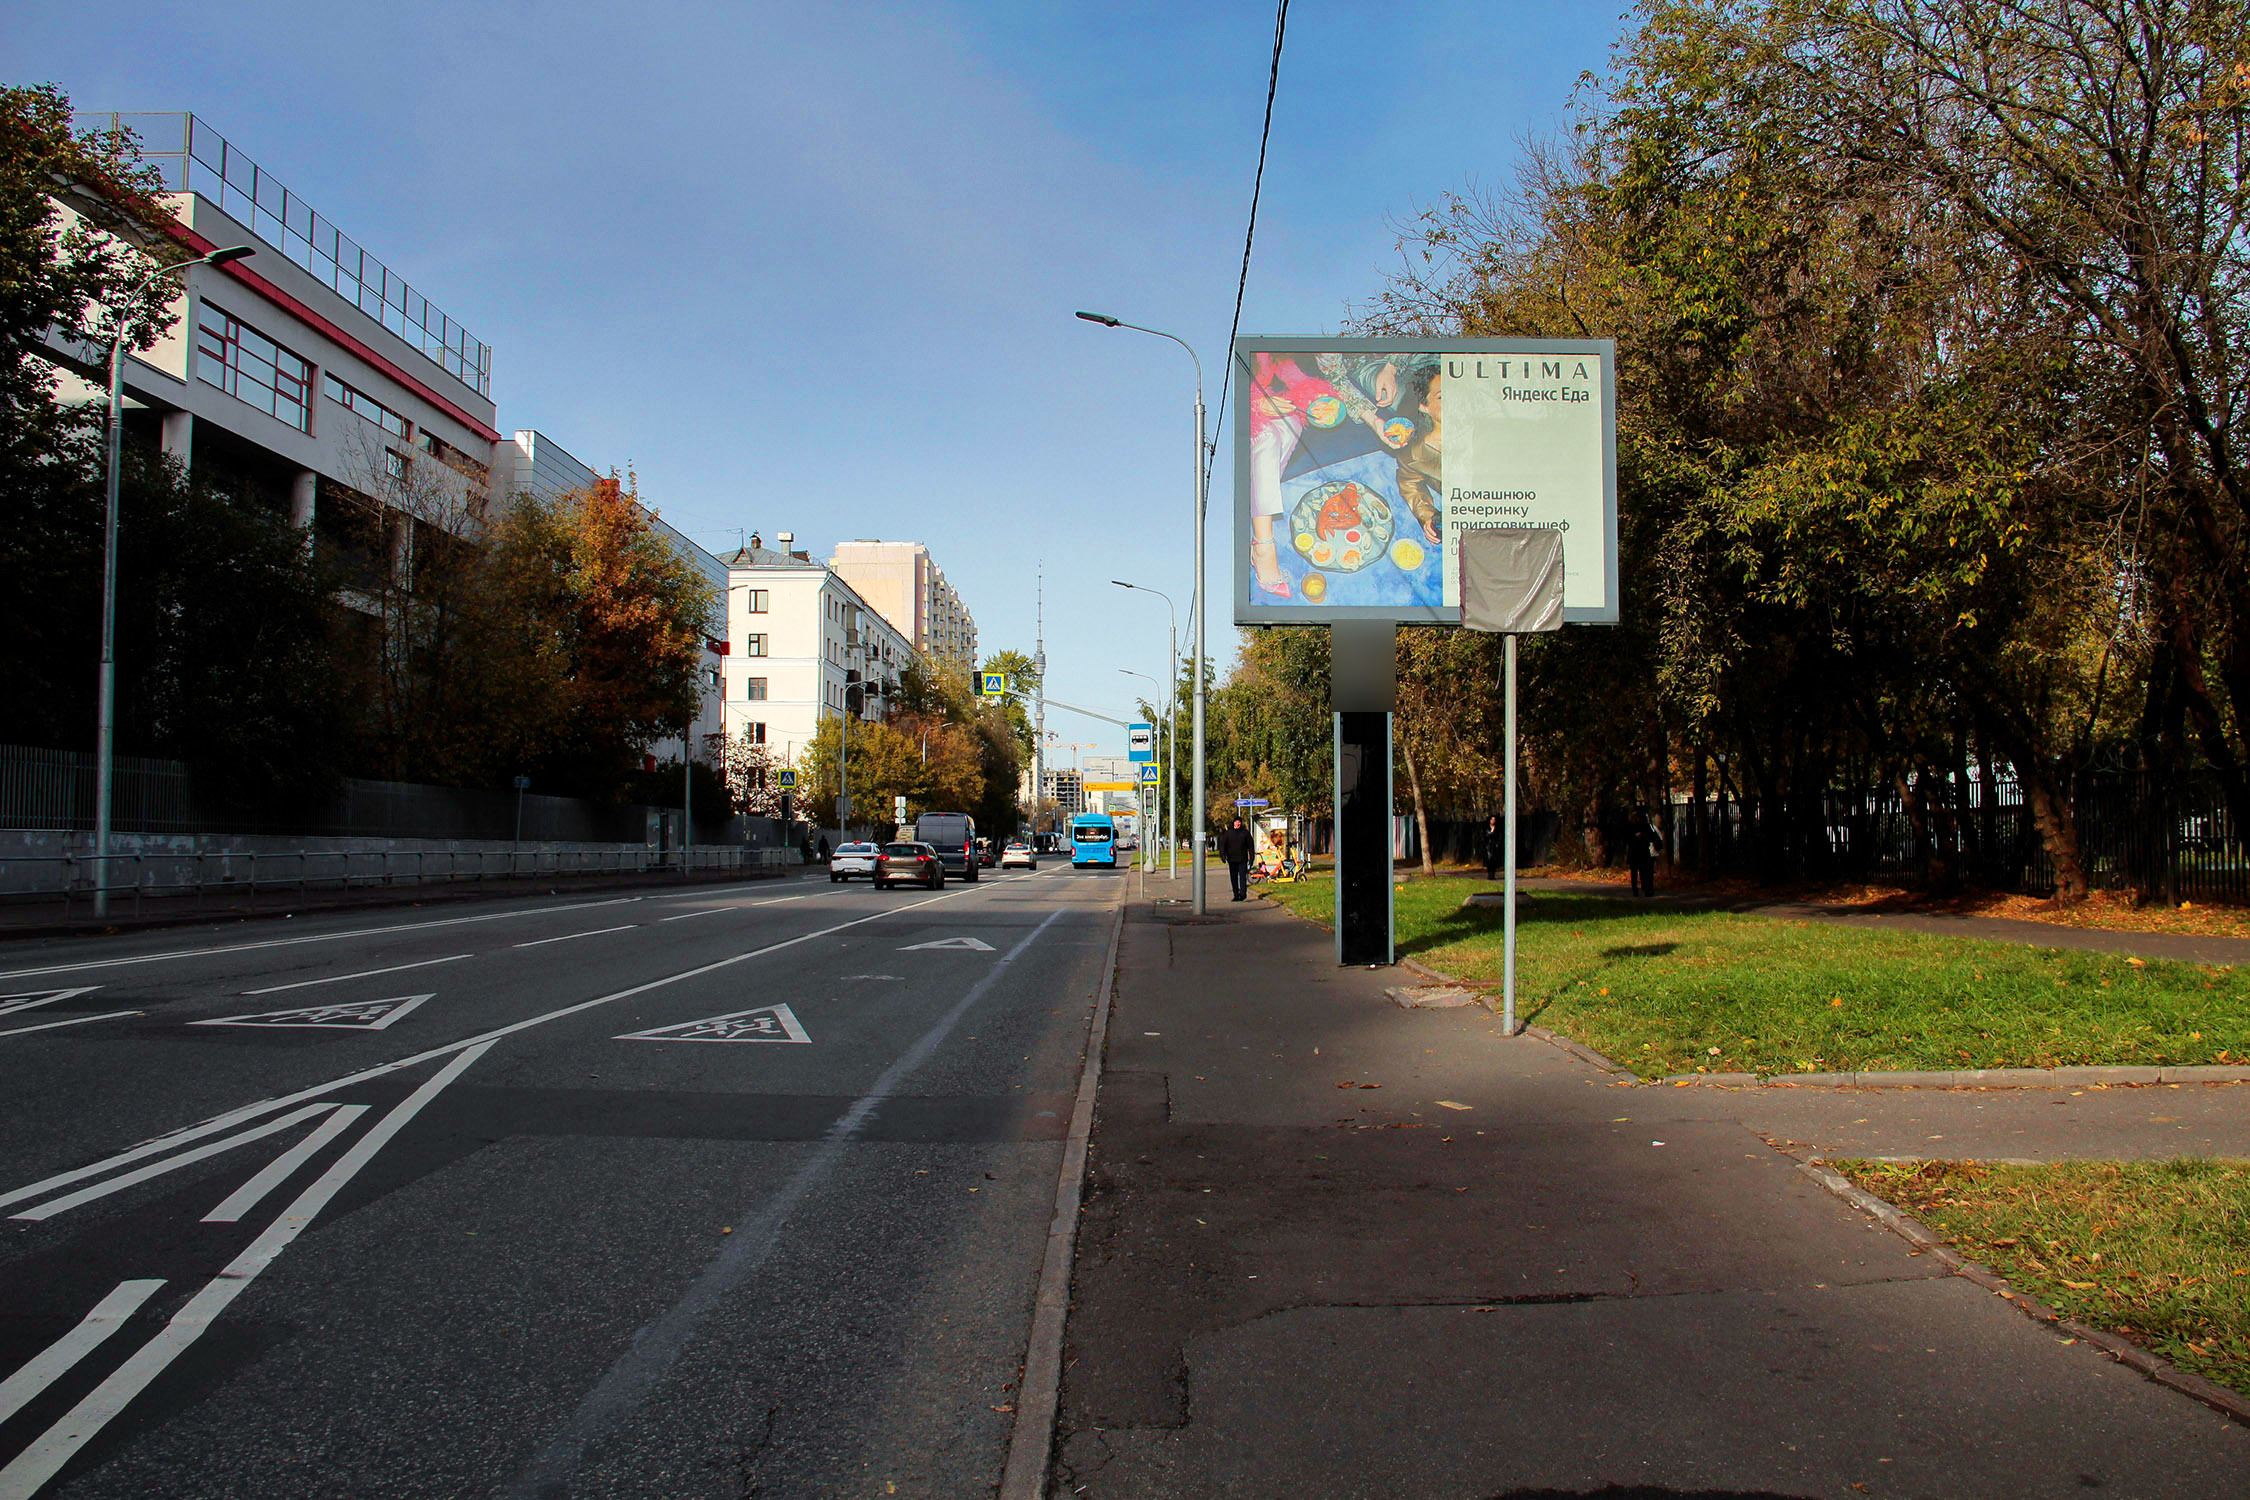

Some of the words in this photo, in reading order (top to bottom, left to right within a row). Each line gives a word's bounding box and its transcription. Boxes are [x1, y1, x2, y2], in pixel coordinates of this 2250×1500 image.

[1448, 361, 1589, 379] ULTIMA
[1502, 386, 1558, 402] Яндекс
[1561, 387, 1590, 403] Еда
[1450, 487, 1537, 502] Домашнюю
[1451, 505, 1529, 518] вечеринку
[1451, 520, 1535, 530] приготовит
[1538, 519, 1570, 533] шеф
